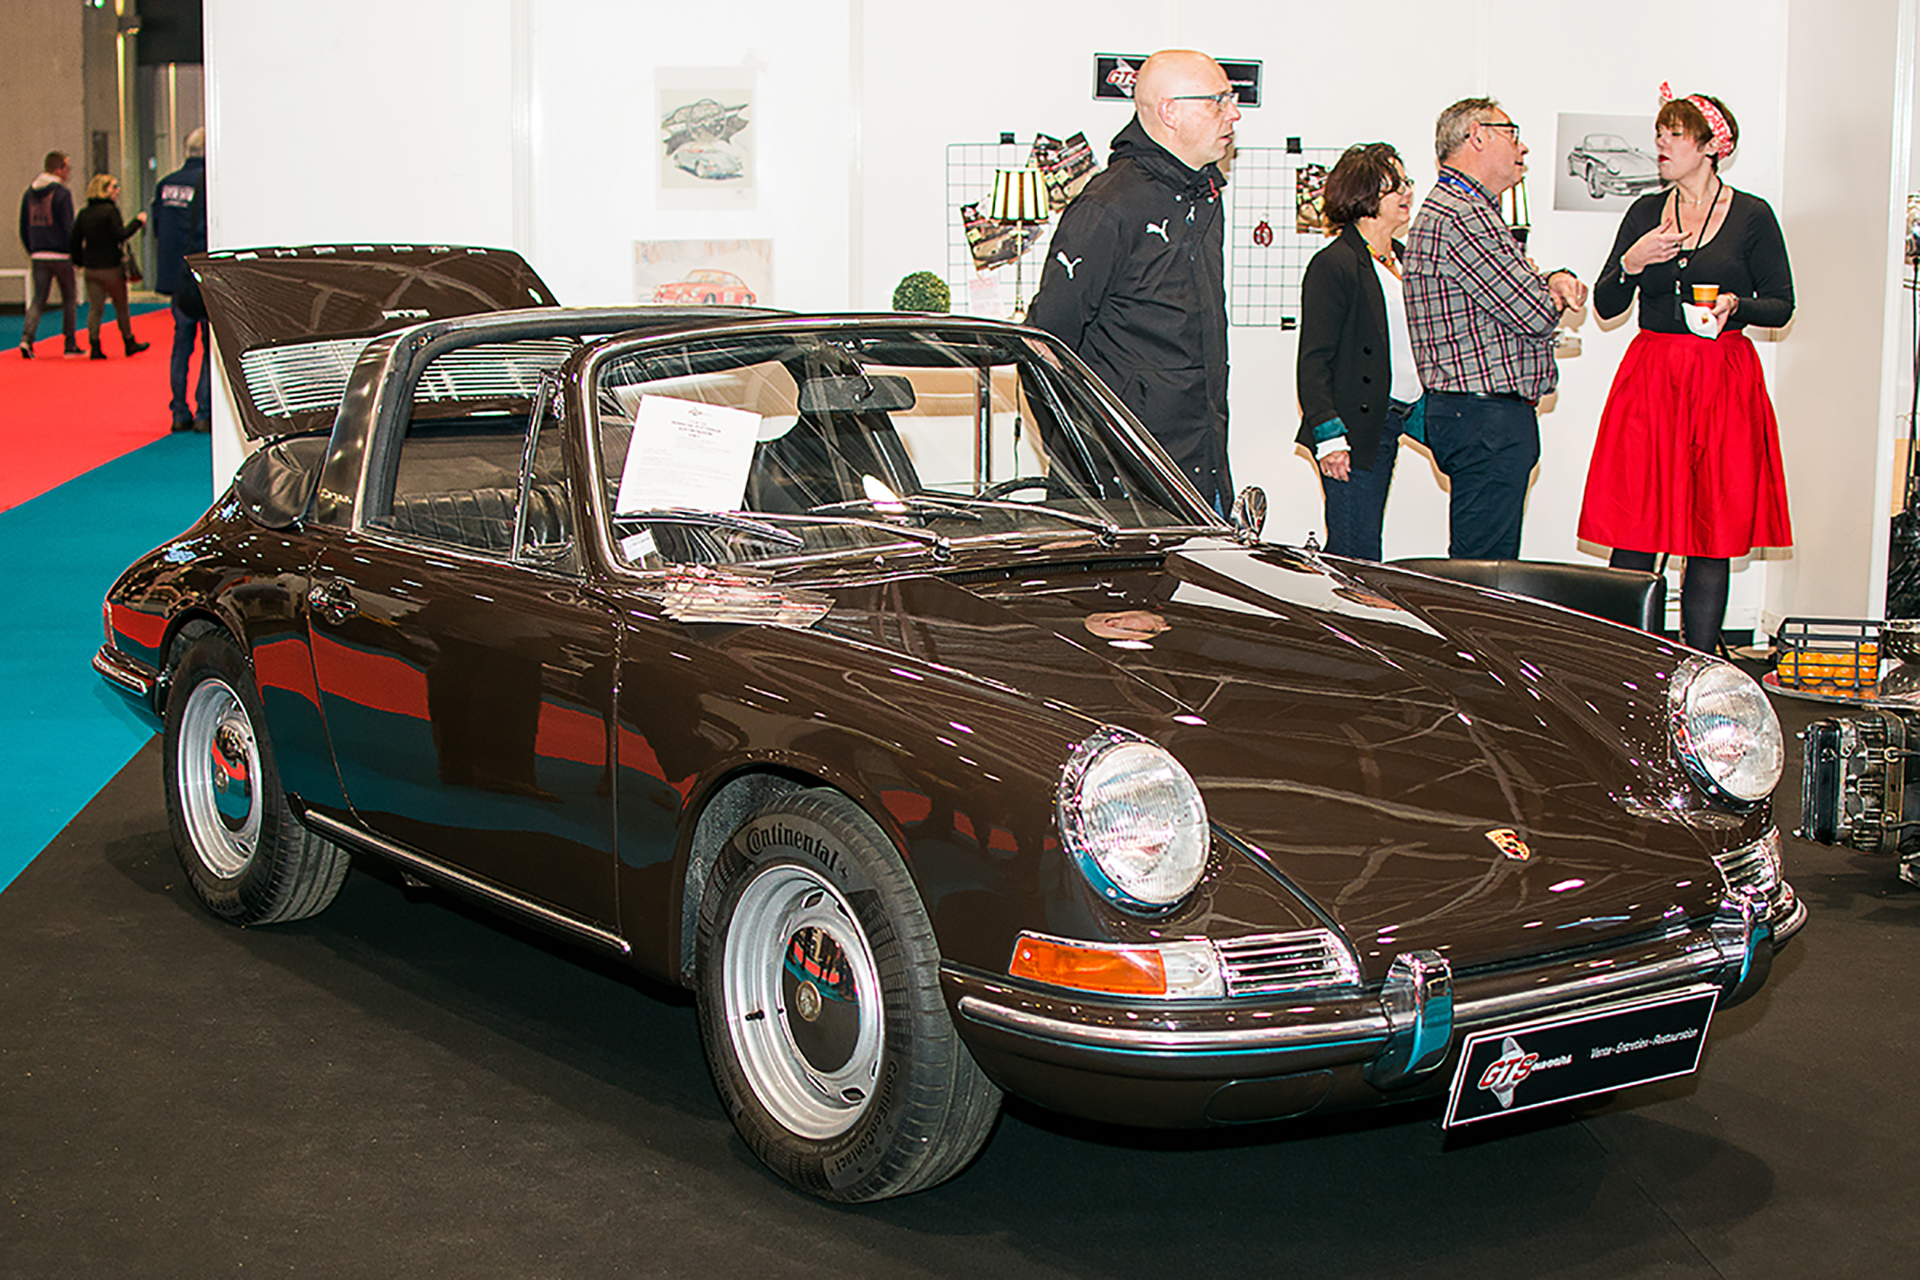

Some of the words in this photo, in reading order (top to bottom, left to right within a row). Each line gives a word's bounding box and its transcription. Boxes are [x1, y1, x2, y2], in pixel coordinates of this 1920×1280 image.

[1107, 69, 1138, 86] GTS
[747, 822, 840, 872] Continental
[1479, 1053, 1539, 1089] GTS
